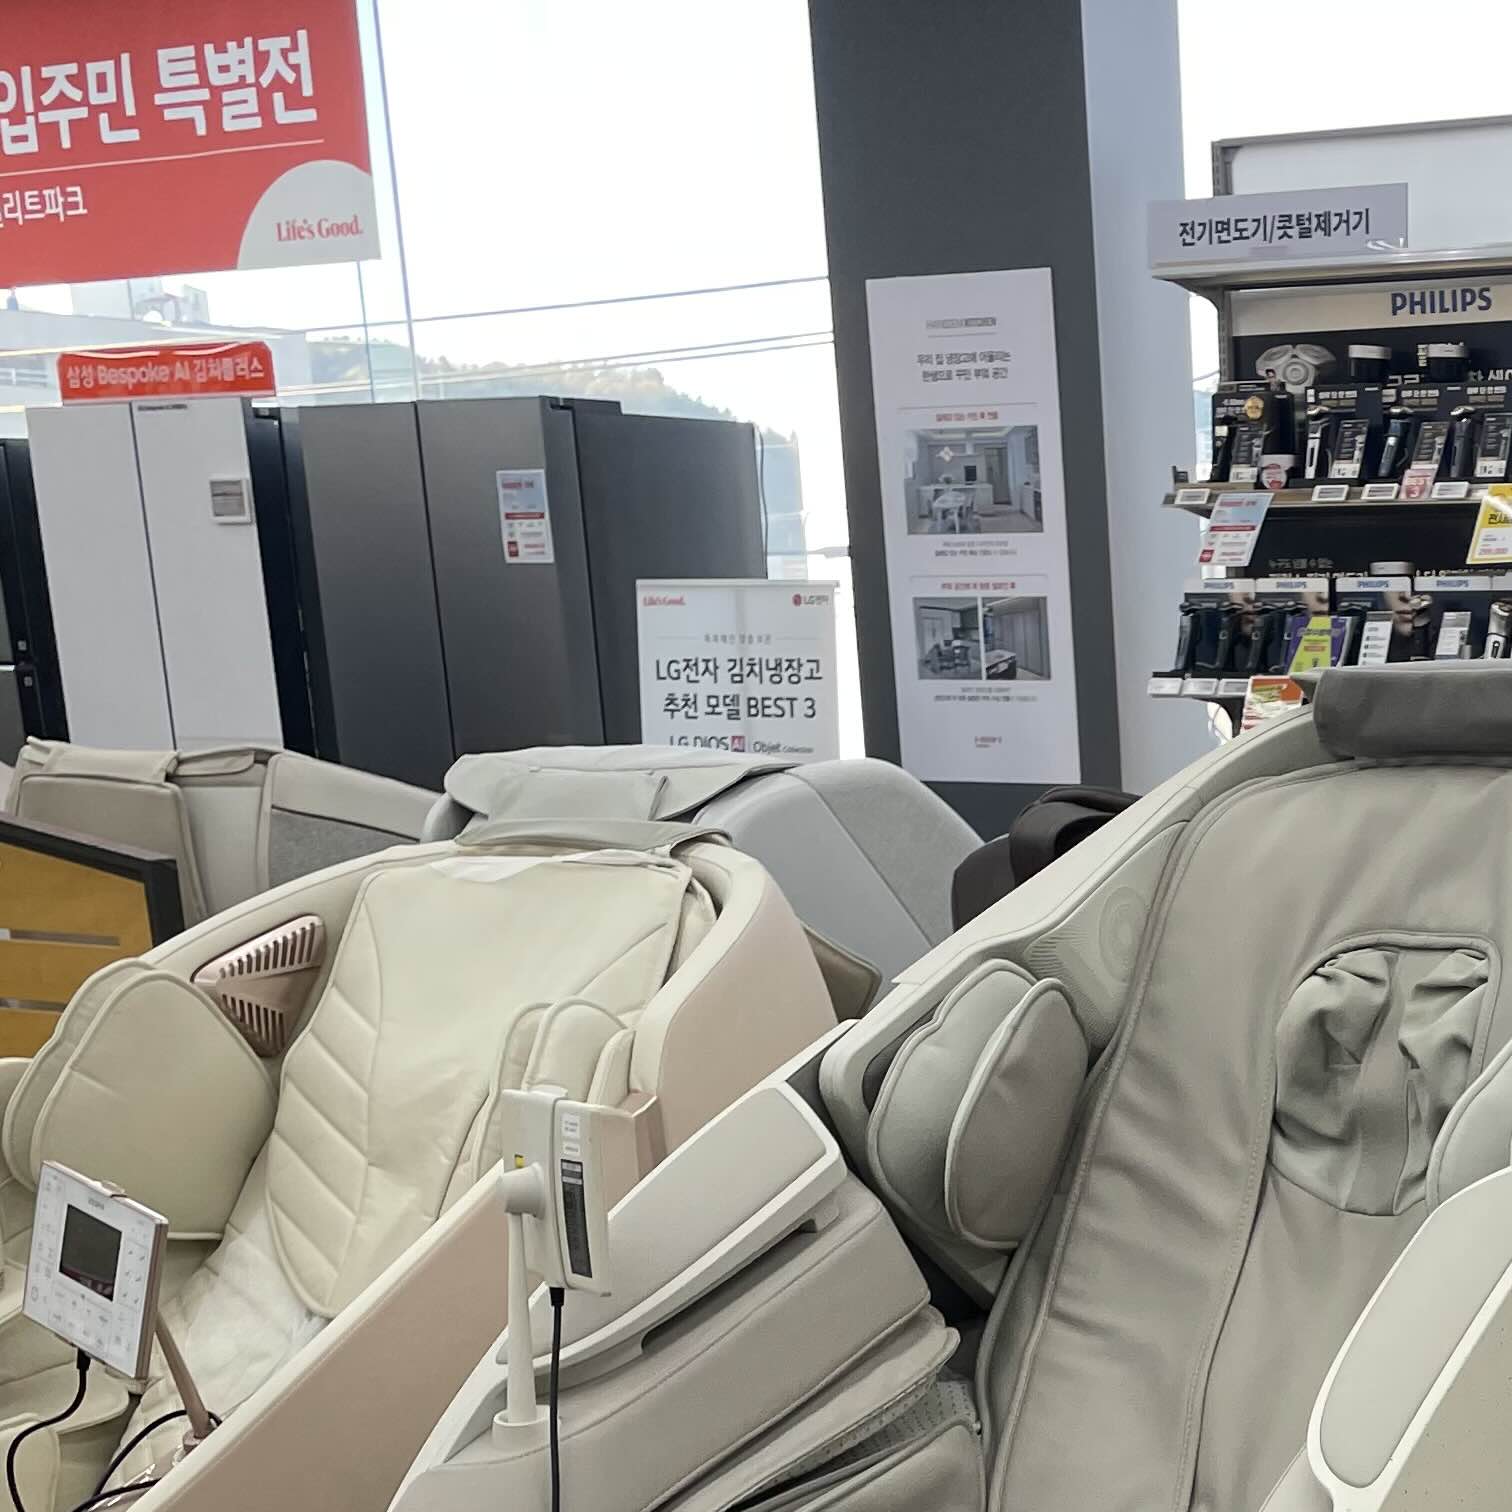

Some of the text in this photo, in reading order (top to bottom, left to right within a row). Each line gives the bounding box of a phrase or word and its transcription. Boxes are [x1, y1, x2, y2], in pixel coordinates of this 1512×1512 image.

[0, 29, 318, 156] 입주민 특별전
[0, 186, 88, 228] 리트파크
[276, 219, 315, 242] Life's
[1179, 208, 1370, 247] 전기면도기/콧털제거기
[1391, 286, 1492, 316] PHILIPS
[98, 363, 170, 389] Bespoke
[174, 363, 191, 380] AI
[656, 656, 823, 684] LG전자 김치냉장고
[663, 693, 816, 721] 추천 모델 BEST 3
